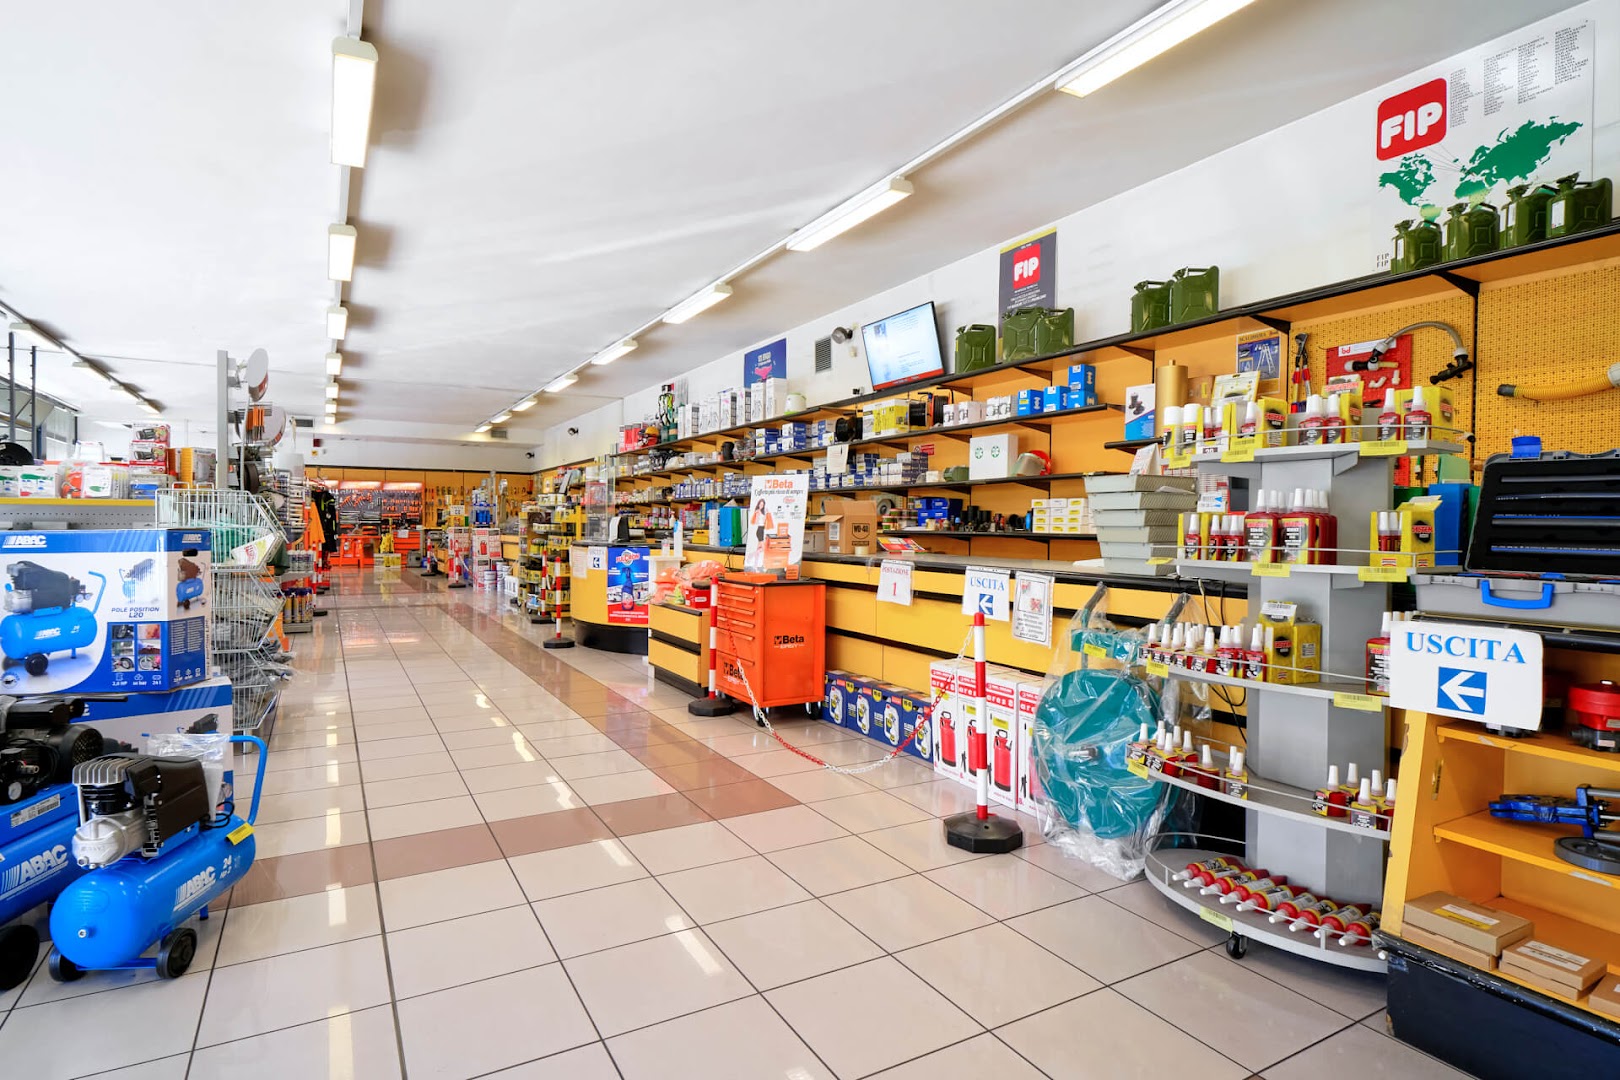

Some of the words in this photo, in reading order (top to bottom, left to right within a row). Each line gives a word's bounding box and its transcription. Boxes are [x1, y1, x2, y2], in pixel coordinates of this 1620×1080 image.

[1381, 103, 1443, 149] FIP
[1014, 256, 1039, 282] FIP
[772, 479, 794, 489] Beta
[853, 525, 869, 533] WD-40
[15, 534, 48, 546] ABAC
[891, 581, 897, 596] 1
[969, 576, 1005, 591] USCITA
[782, 634, 805, 645] Beta
[1405, 631, 1526, 664] USCITA
[986, 694, 1006, 705] ares
[19, 844, 68, 885] ABAC
[186, 865, 216, 899] ABAC
